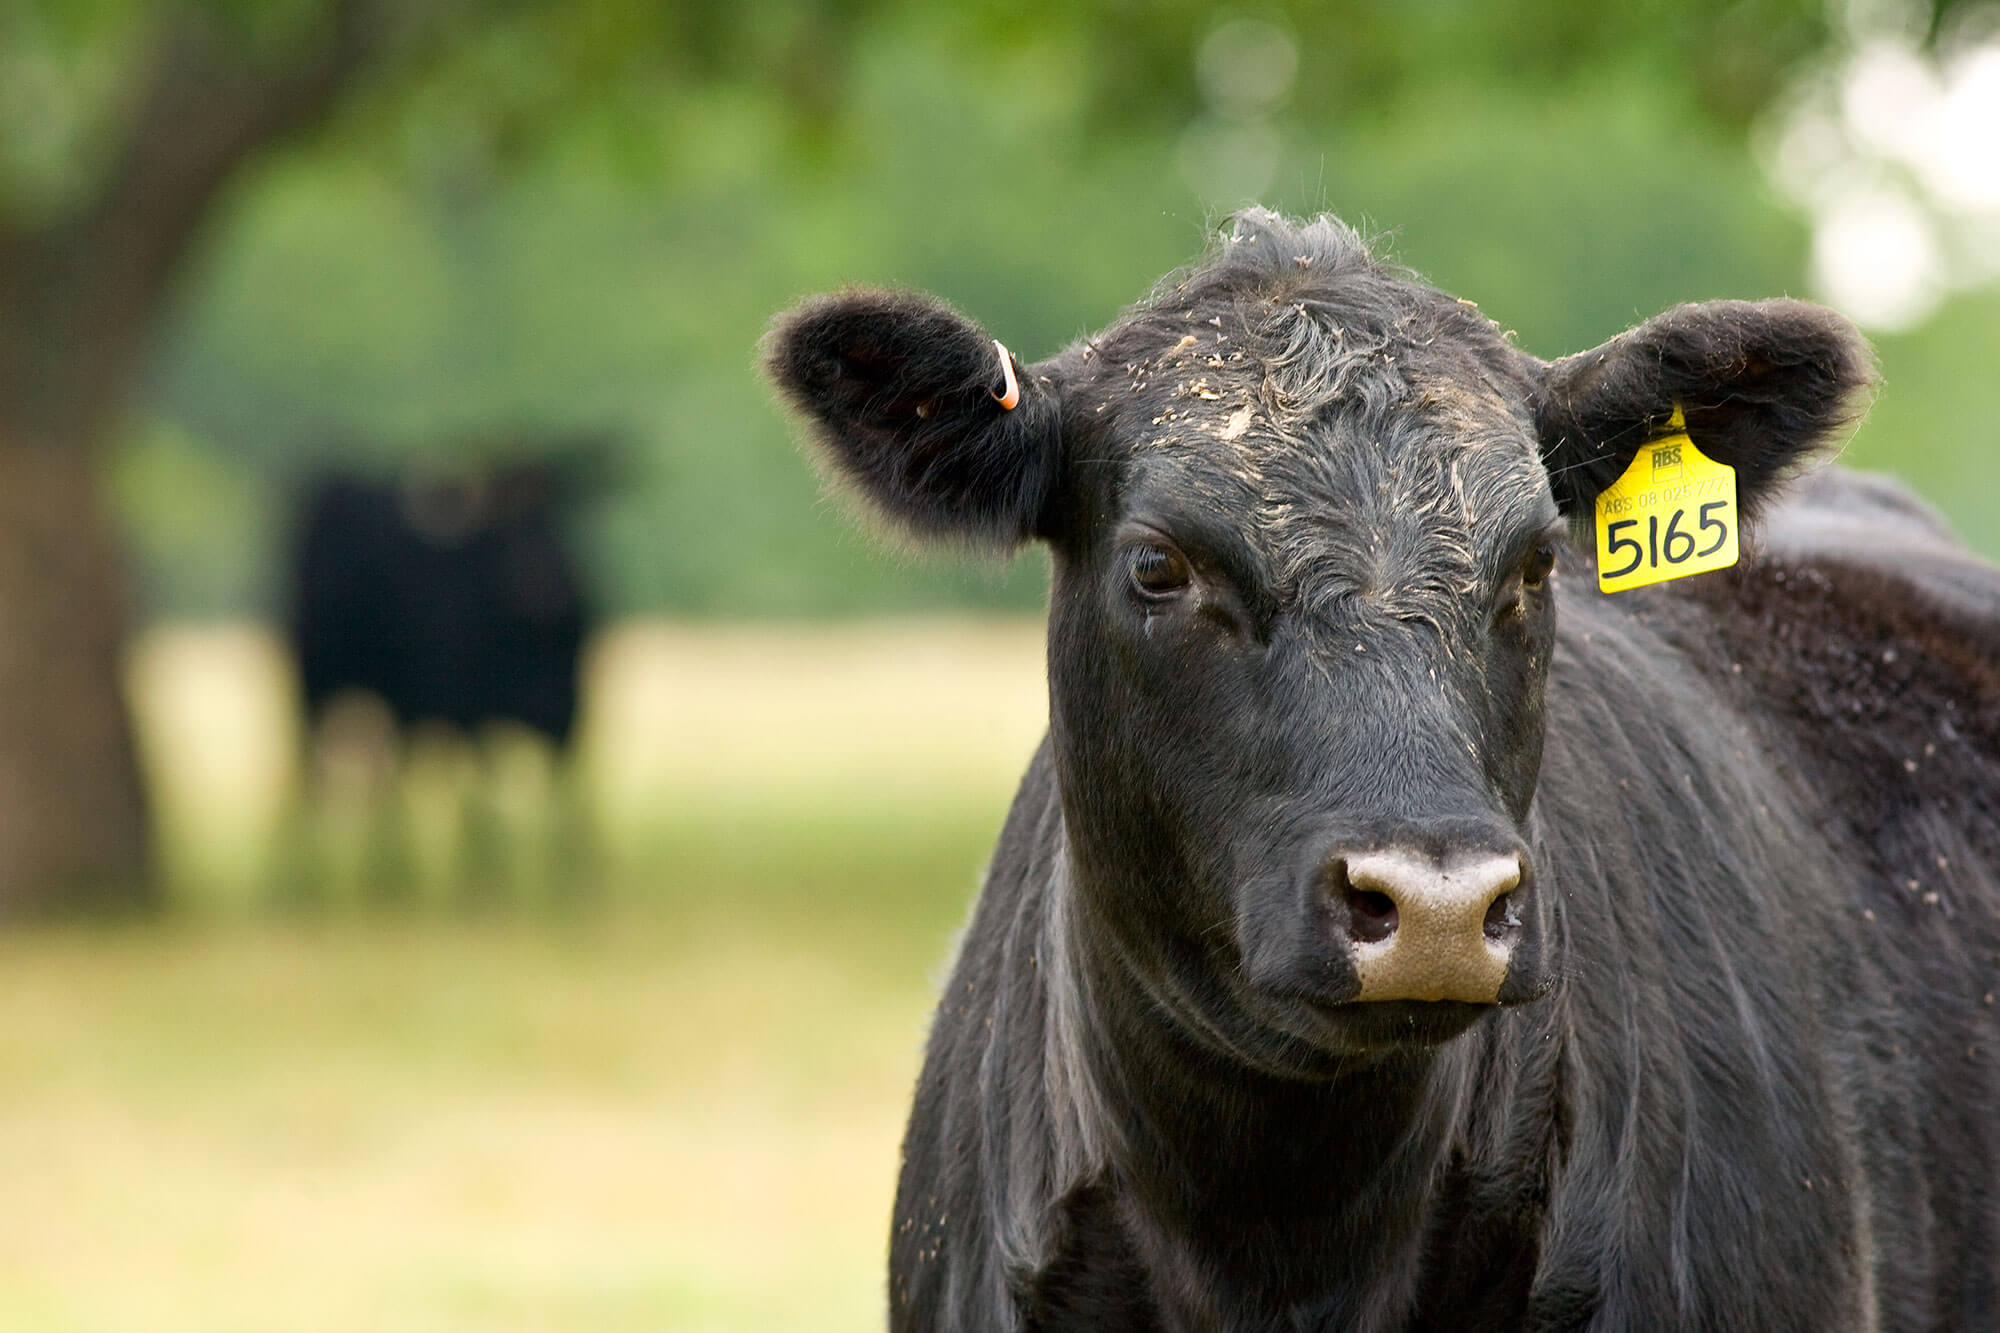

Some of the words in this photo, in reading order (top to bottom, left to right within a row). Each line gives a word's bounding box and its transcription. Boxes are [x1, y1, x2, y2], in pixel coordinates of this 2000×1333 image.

[1652, 447, 1682, 469] ABS
[1604, 497, 1633, 515] ABS
[1602, 501, 1728, 579] 5165
